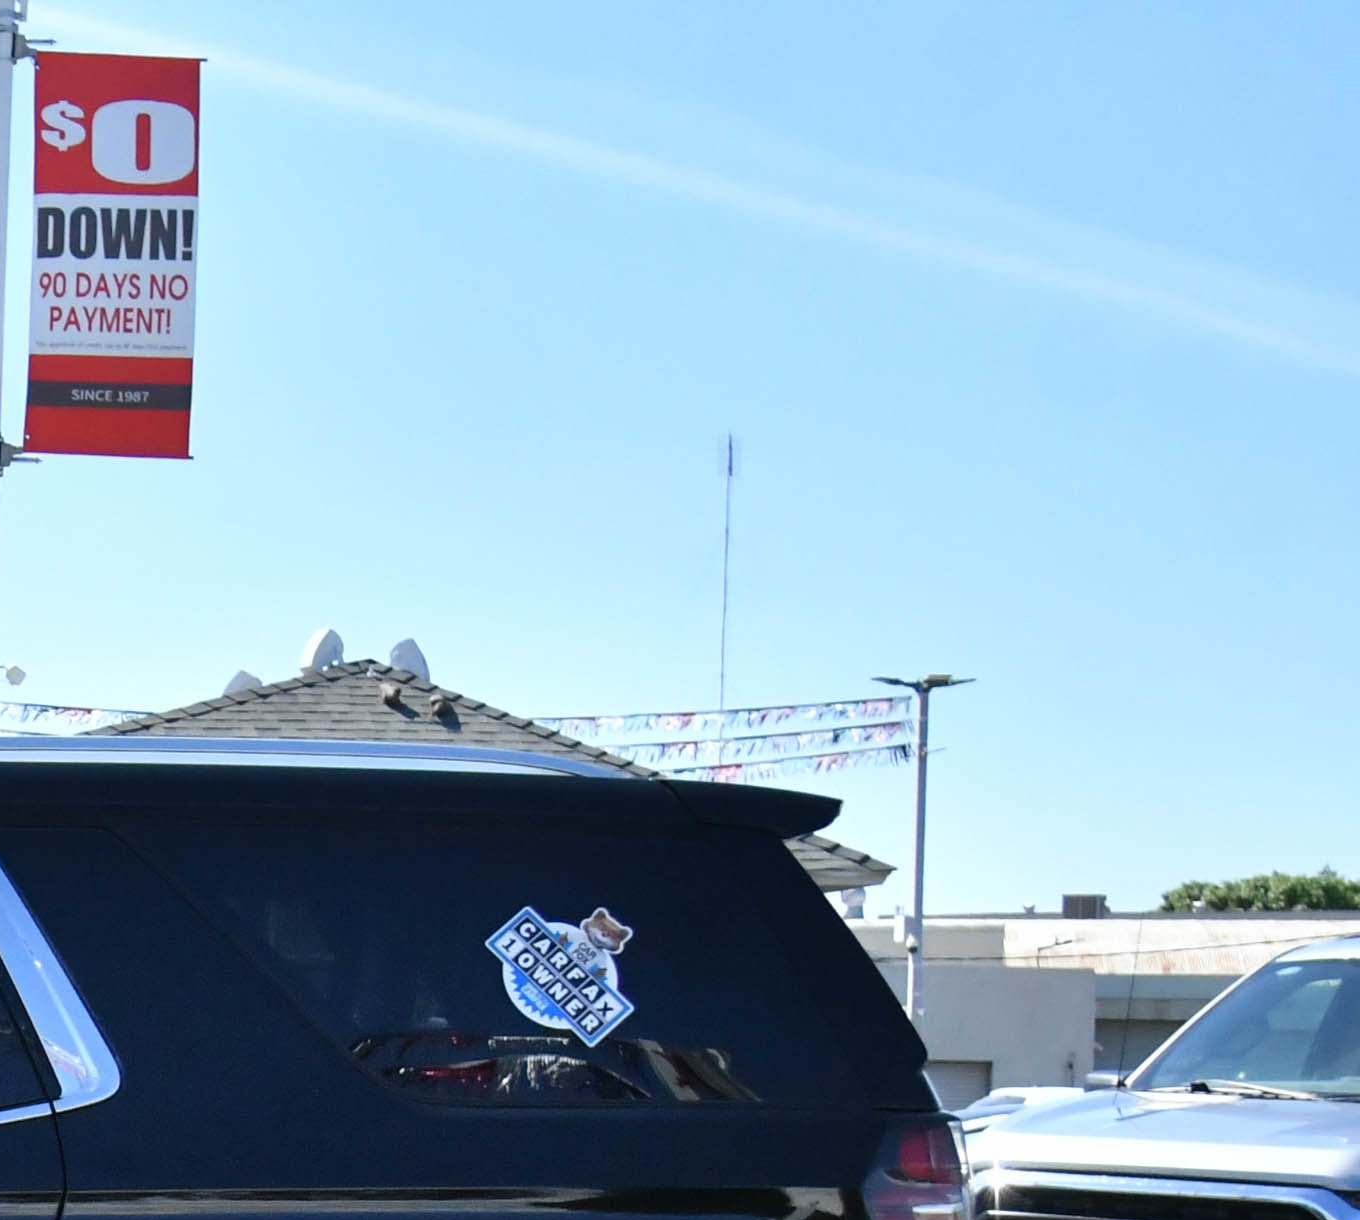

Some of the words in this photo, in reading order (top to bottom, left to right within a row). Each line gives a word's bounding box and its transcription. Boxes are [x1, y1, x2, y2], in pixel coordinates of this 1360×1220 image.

[40, 100, 196, 185] $0
[36, 206, 195, 262] DOWN!
[39, 272, 67, 299] 90
[76, 272, 141, 300] DAYS
[149, 273, 189, 302] NO
[48, 305, 172, 335] PAYMENT!
[71, 388, 113, 402] SINCE
[117, 390, 150, 403] 1987
[501, 936, 517, 953] 1
[517, 953, 599, 1033] OWNER
[519, 921, 614, 1017] CARFAX
